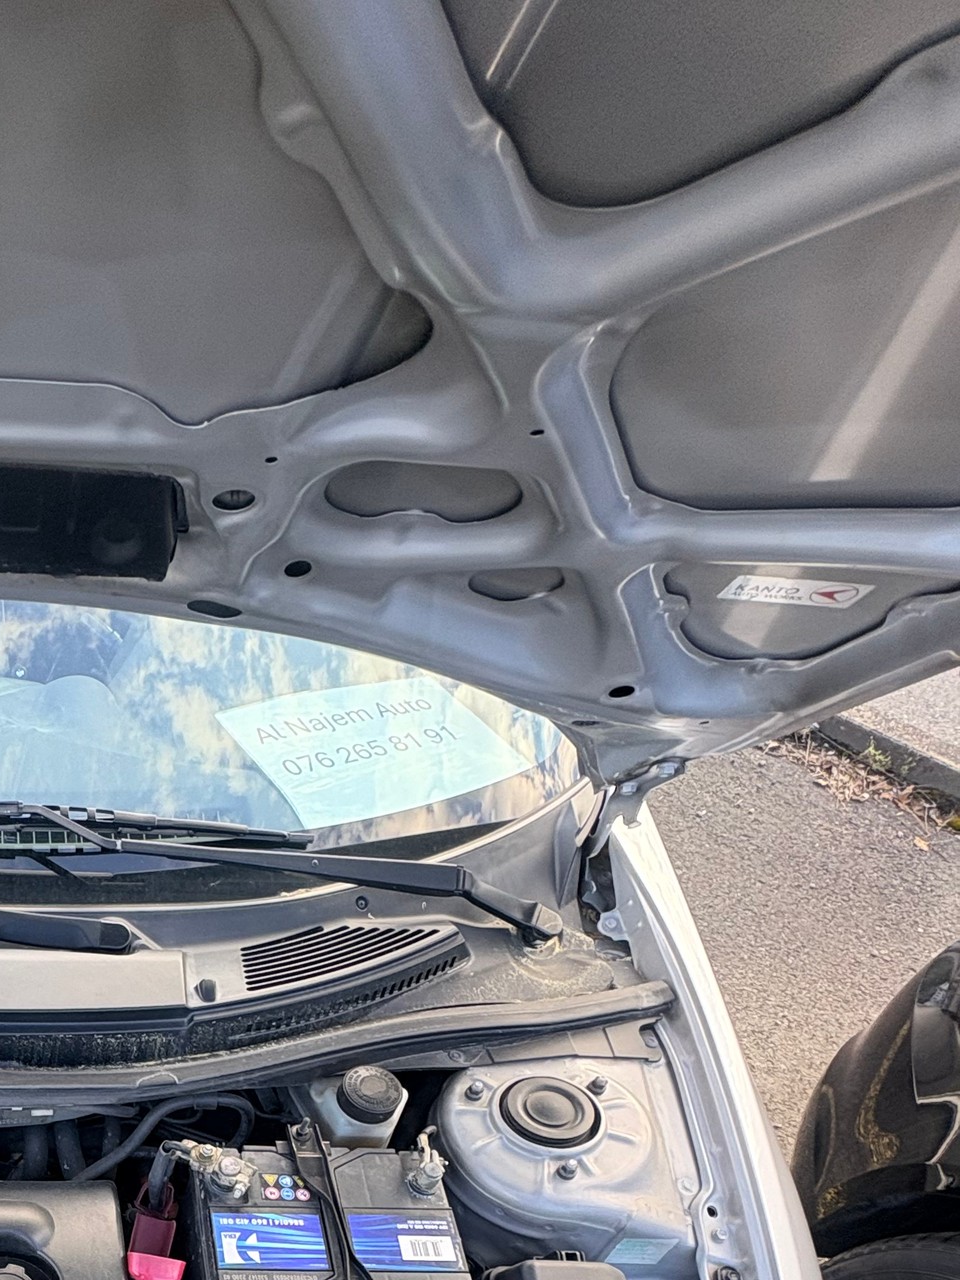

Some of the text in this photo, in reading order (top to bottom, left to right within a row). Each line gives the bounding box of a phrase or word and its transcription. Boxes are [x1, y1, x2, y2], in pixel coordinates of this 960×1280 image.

[735, 583, 800, 594] KANTO
[256, 696, 433, 744] Al Najem Auto
[281, 724, 458, 777] 076 265 81 91
